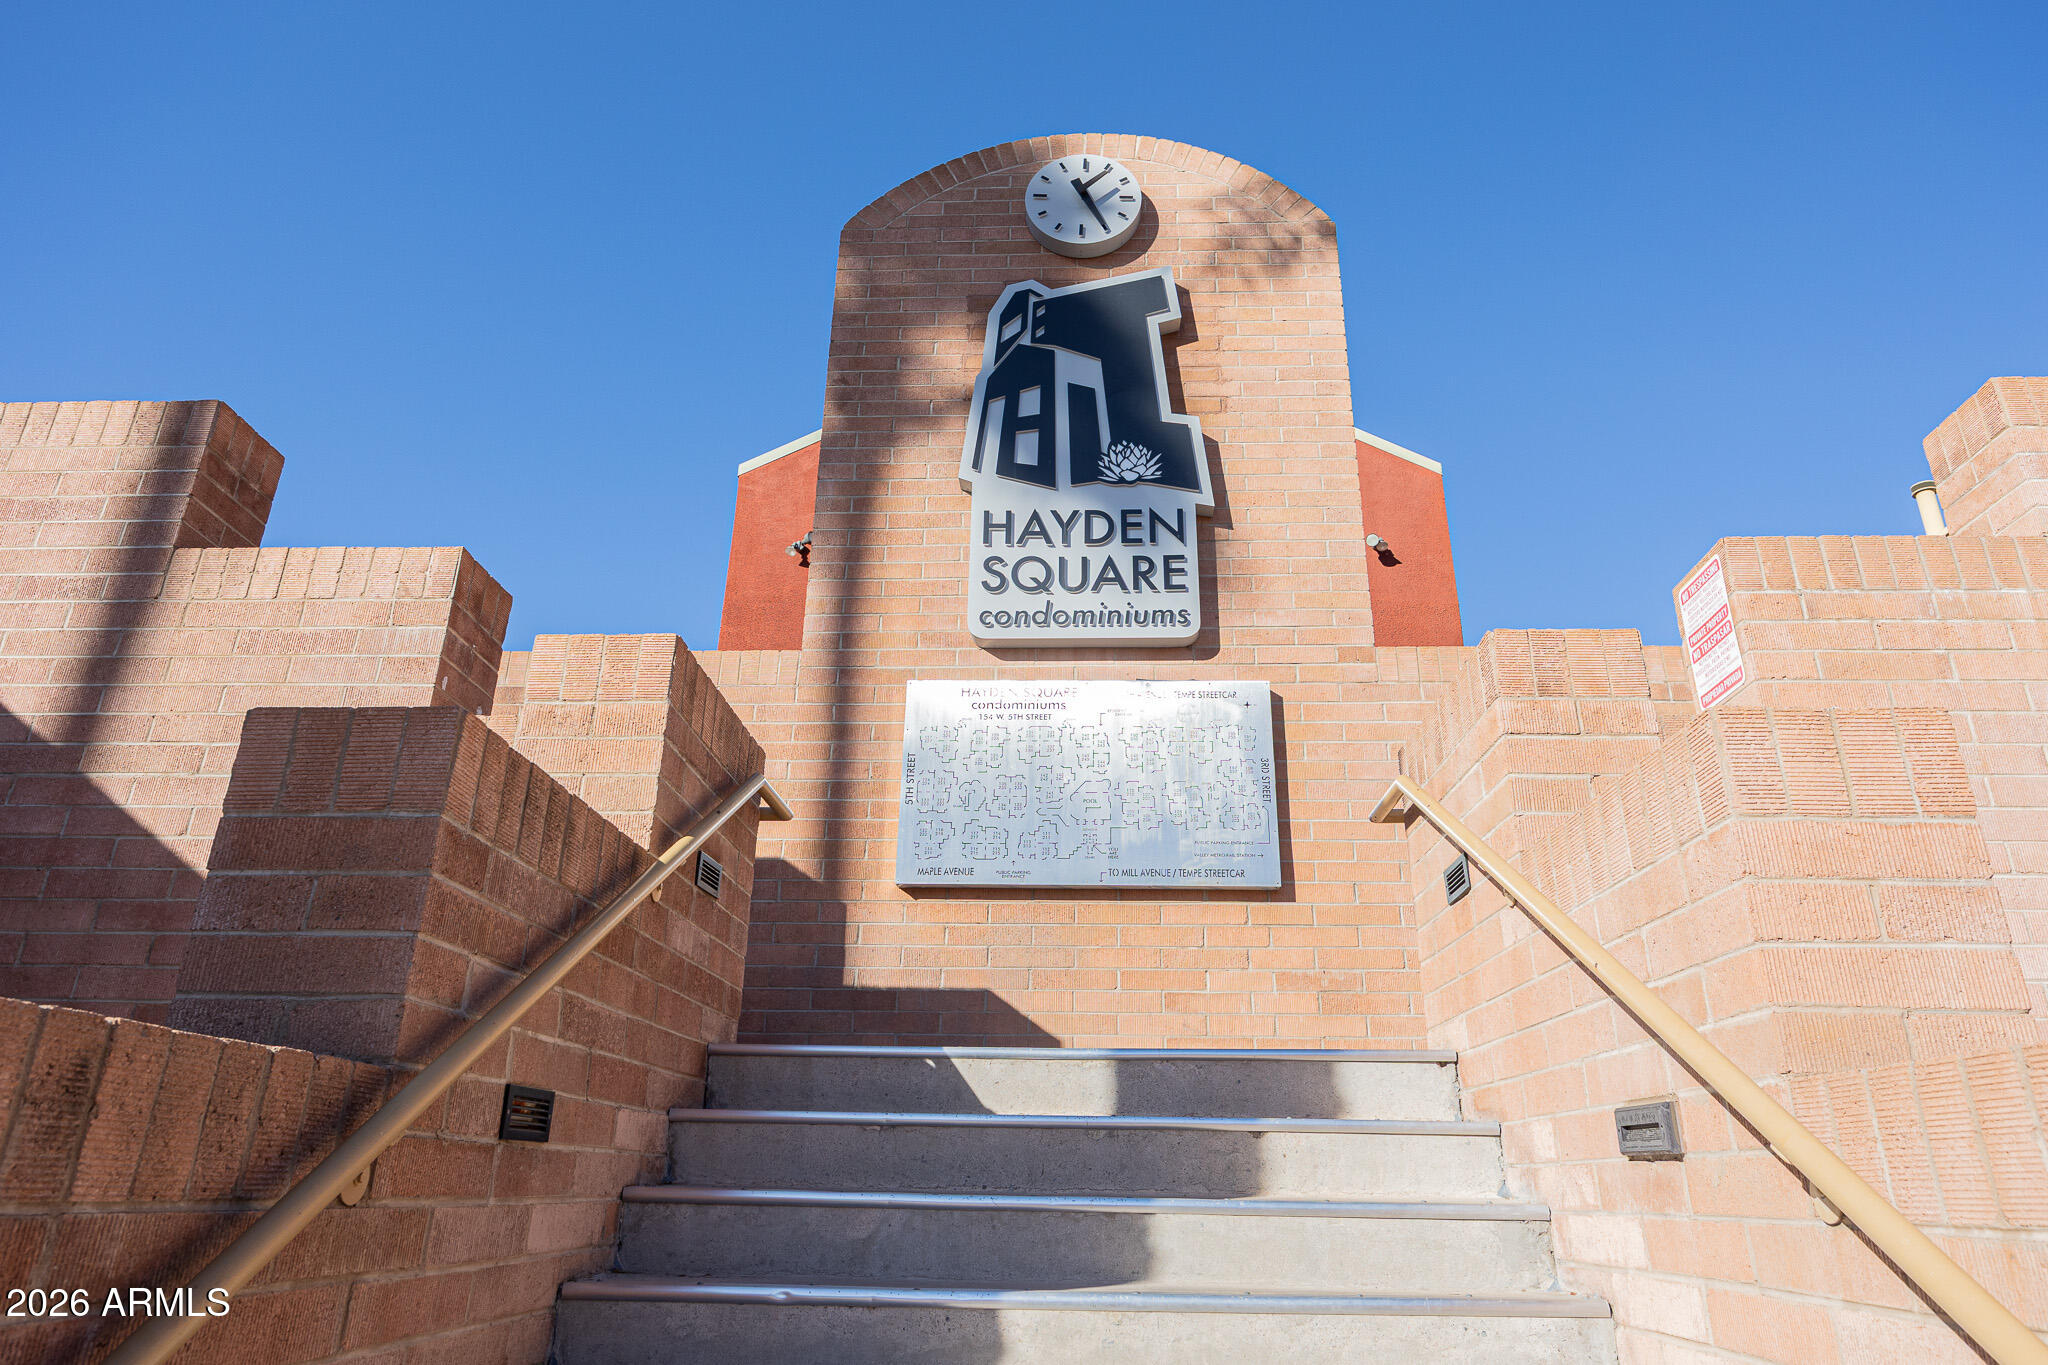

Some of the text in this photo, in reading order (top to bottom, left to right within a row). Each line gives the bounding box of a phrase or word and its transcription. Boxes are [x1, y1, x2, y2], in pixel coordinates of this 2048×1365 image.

[982, 508, 1187, 546] HAYDEN
[981, 554, 1188, 594] SQUARE
[979, 600, 1191, 627] condominiums
[1700, 622, 1730, 654] TRASPASAR
[961, 688, 1017, 697] HAYDN
[972, 700, 1066, 710] condominiums
[905, 752, 916, 805] 5TH STREET
[1261, 758, 1271, 803] 3RD STREET
[917, 868, 974, 876] MAPLE AVENUE
[1108, 868, 1119, 877] TO
[1122, 868, 1138, 877] MILL
[1140, 868, 1171, 878] AVENUE
[1178, 869, 1201, 877] TEMPE
[1204, 869, 1245, 878] STREETCAR
